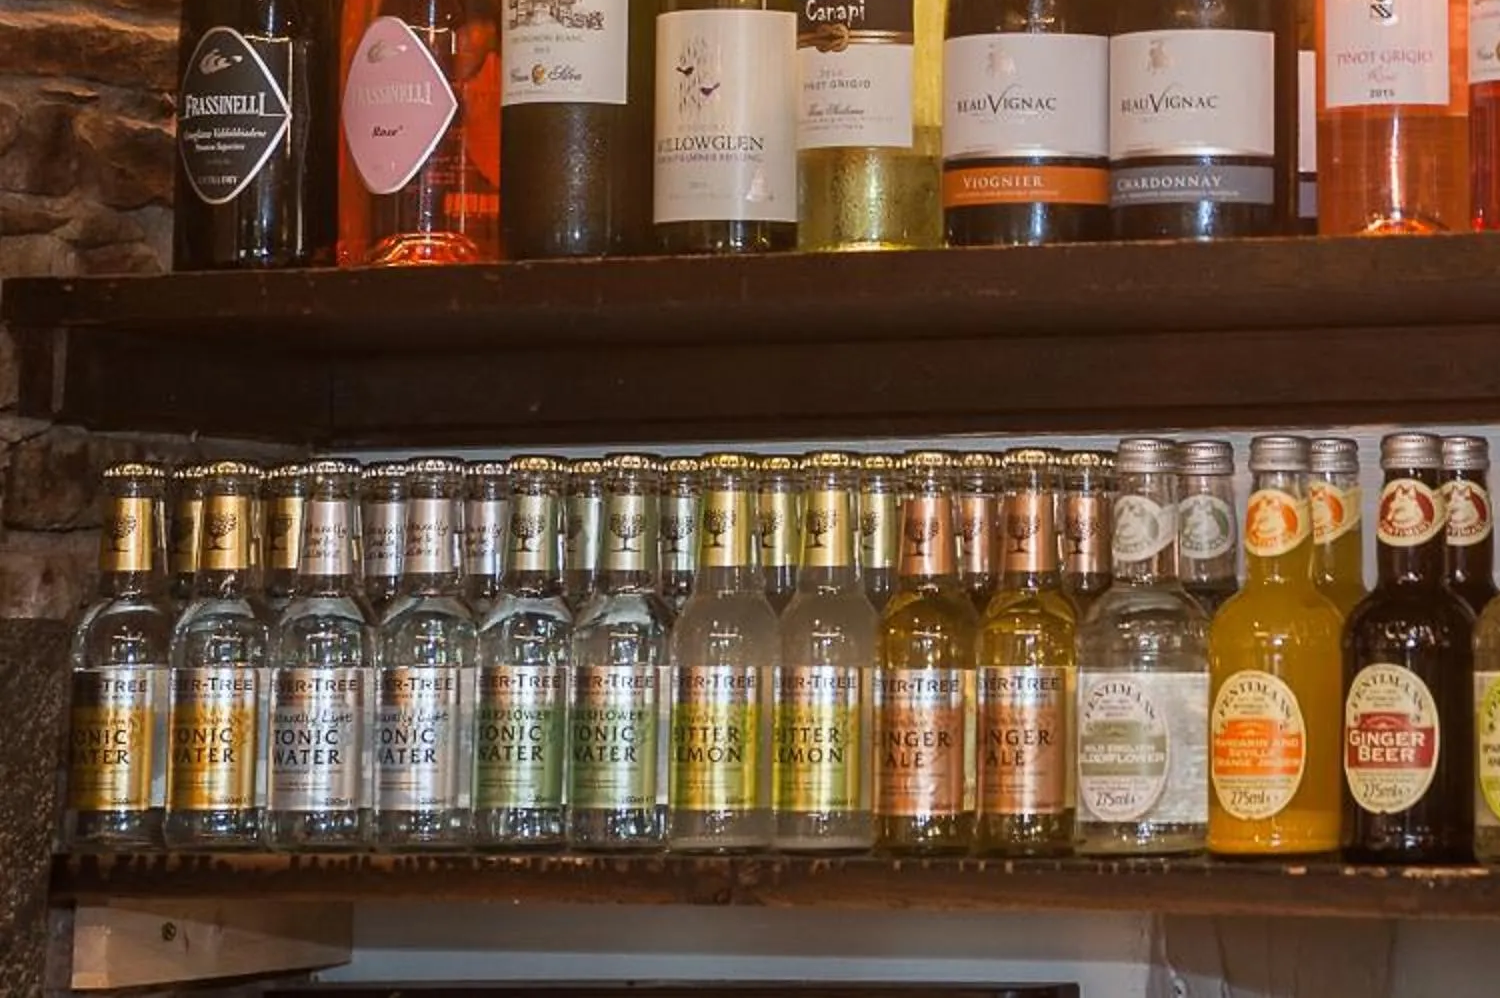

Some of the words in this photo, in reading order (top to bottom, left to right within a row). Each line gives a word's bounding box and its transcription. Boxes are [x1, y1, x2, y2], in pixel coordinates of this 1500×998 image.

[1337, 51, 1375, 66] PINOT
[1380, 49, 1433, 64] GRIGIO
[185, 91, 267, 119] FRASSINELLI
[962, 174, 1045, 190] VIOGNIER
[1117, 173, 1222, 192] CHARDONNAY
[73, 729, 127, 745] ONIC
[176, 728, 233, 744] ONIC
[381, 728, 436, 745] ONIC
[880, 731, 951, 748] INGER
[1350, 729, 1426, 747] GINGER
[886, 752, 926, 769] ALE
[986, 751, 1025, 767] ALE
[1358, 746, 1416, 763] BEER
